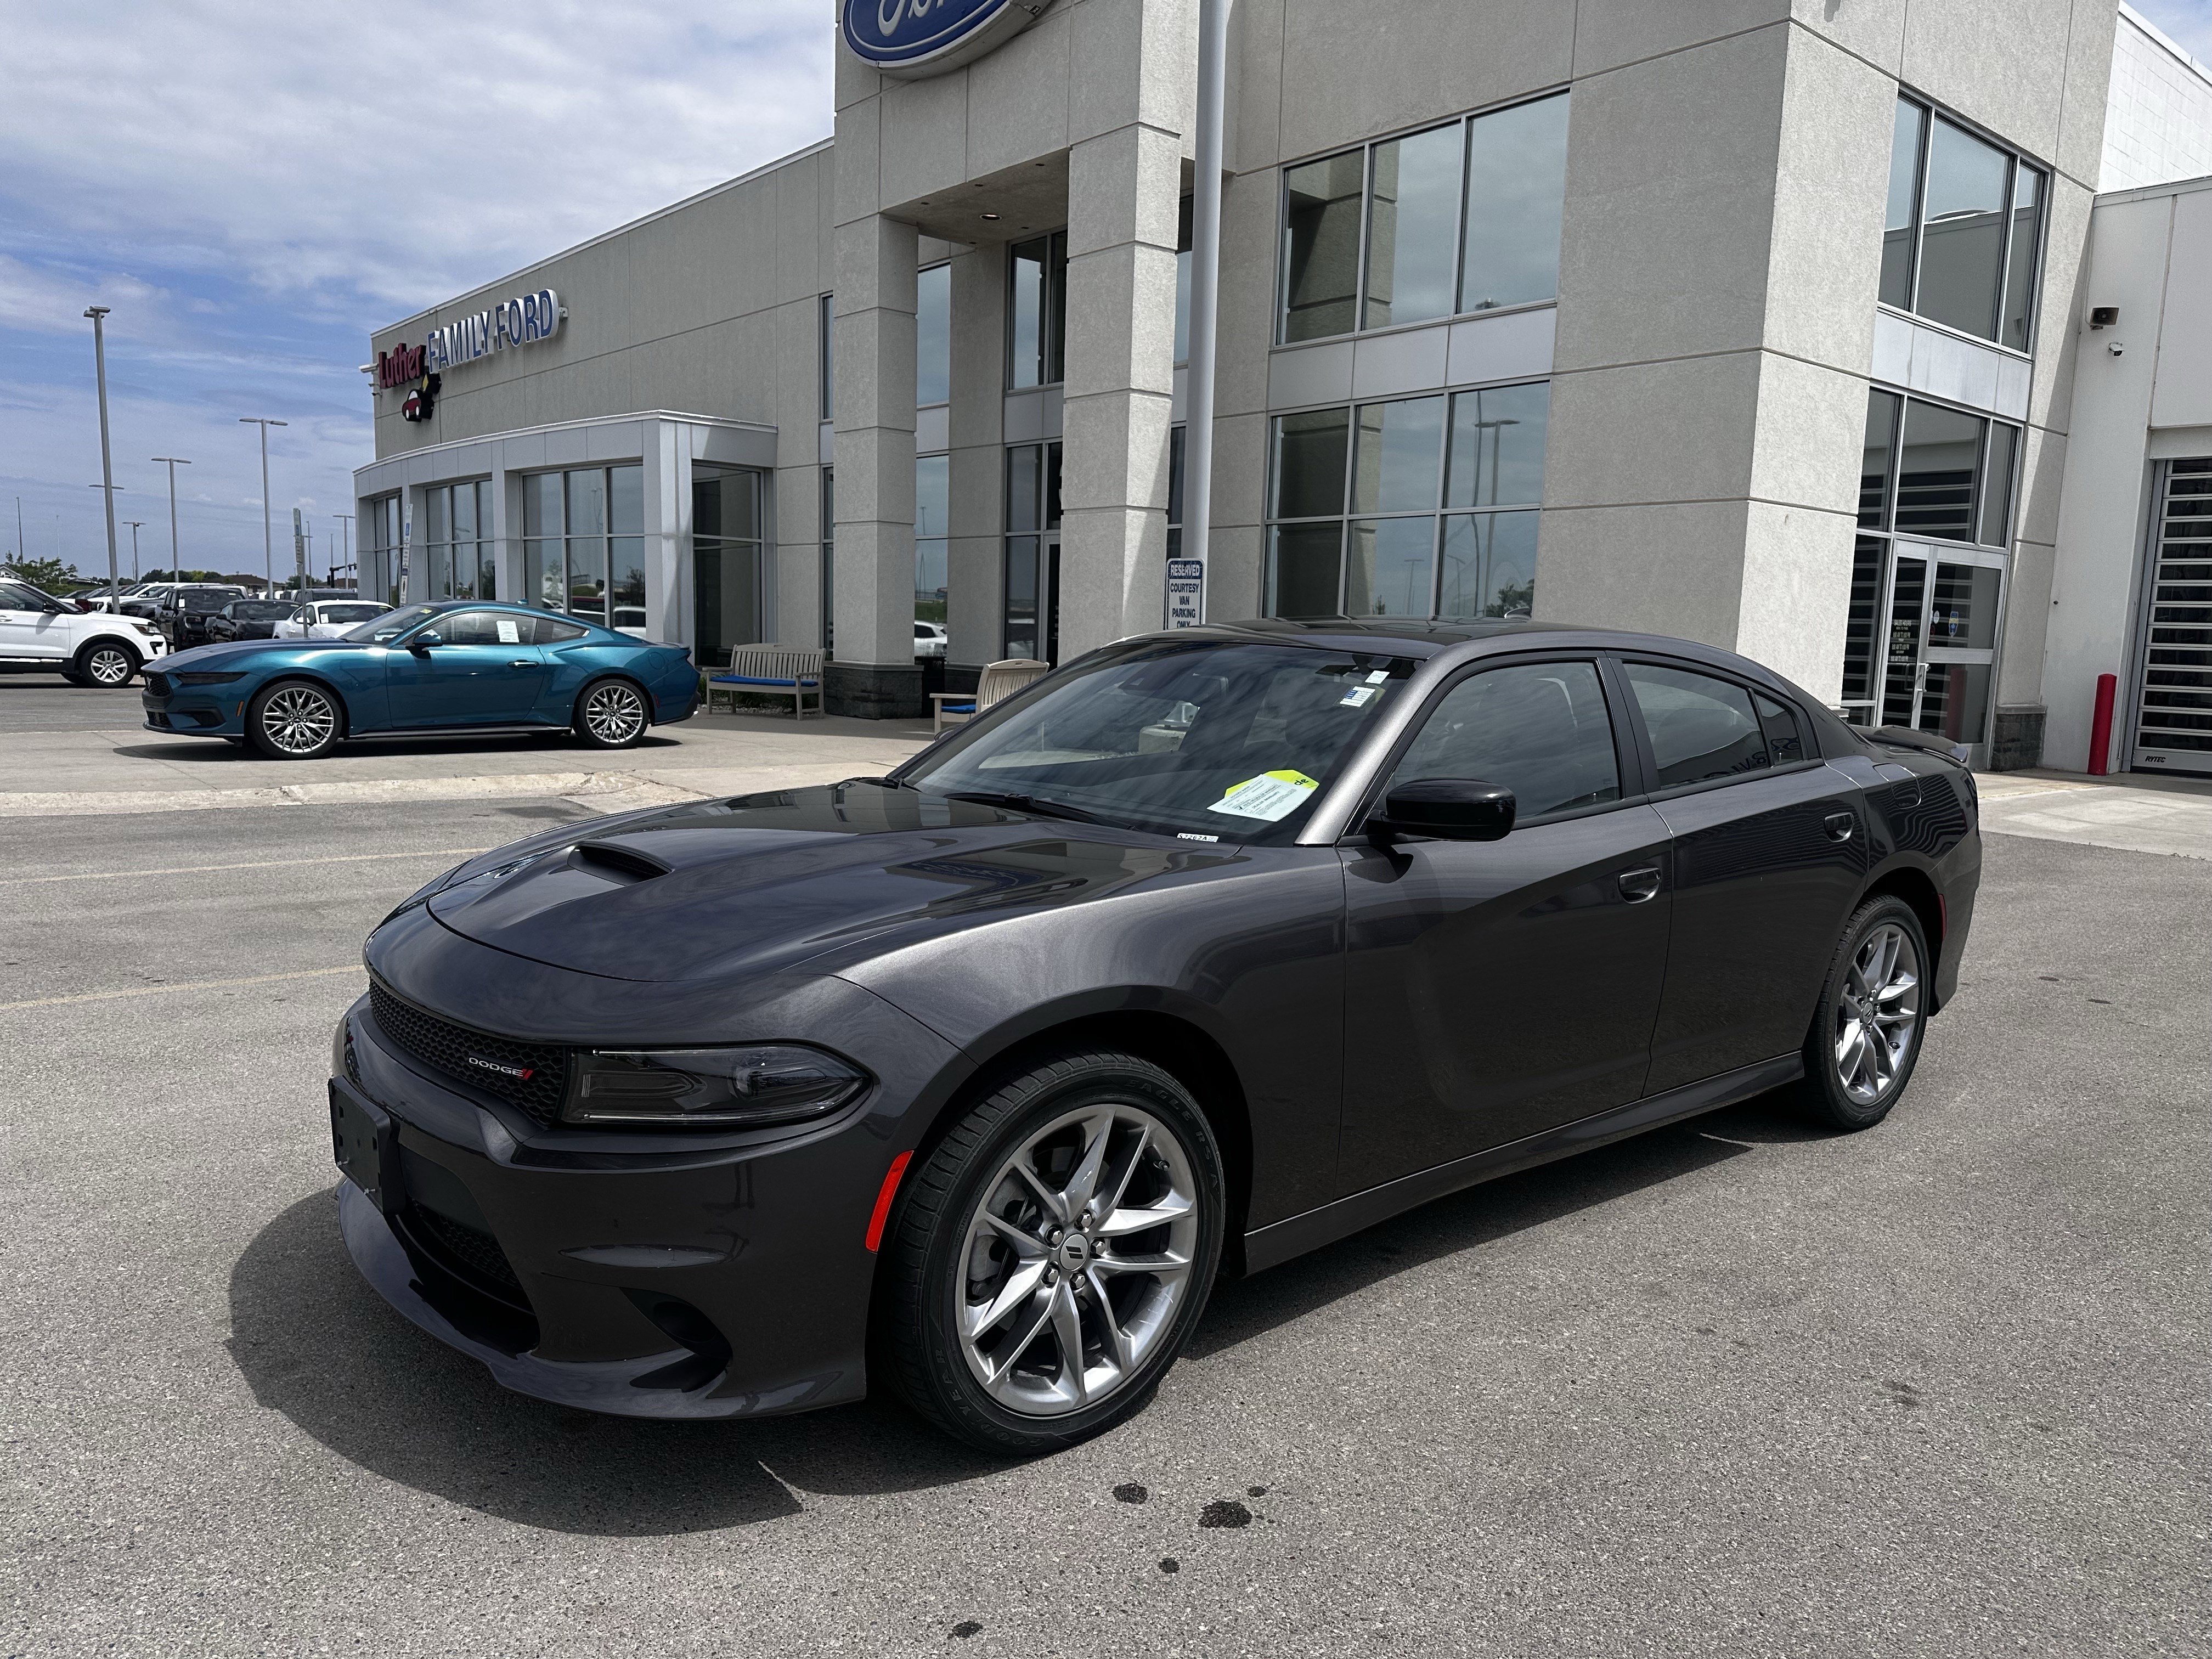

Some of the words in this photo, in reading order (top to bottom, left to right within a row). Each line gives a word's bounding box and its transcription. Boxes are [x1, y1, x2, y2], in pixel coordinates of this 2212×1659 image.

[379, 343, 426, 390] Luther
[427, 308, 493, 374] FAMILY
[495, 289, 558, 351] FORD
[1170, 564, 1200, 577] RESERVED
[1170, 583, 1199, 593] COURTESY
[1179, 596, 1190, 605] VAN
[1172, 608, 1196, 618] PARKING
[469, 1057, 523, 1077] DODGE
[1124, 1077, 1194, 1122] EAGLE
[934, 1347, 1045, 1447] GOODYEAR
